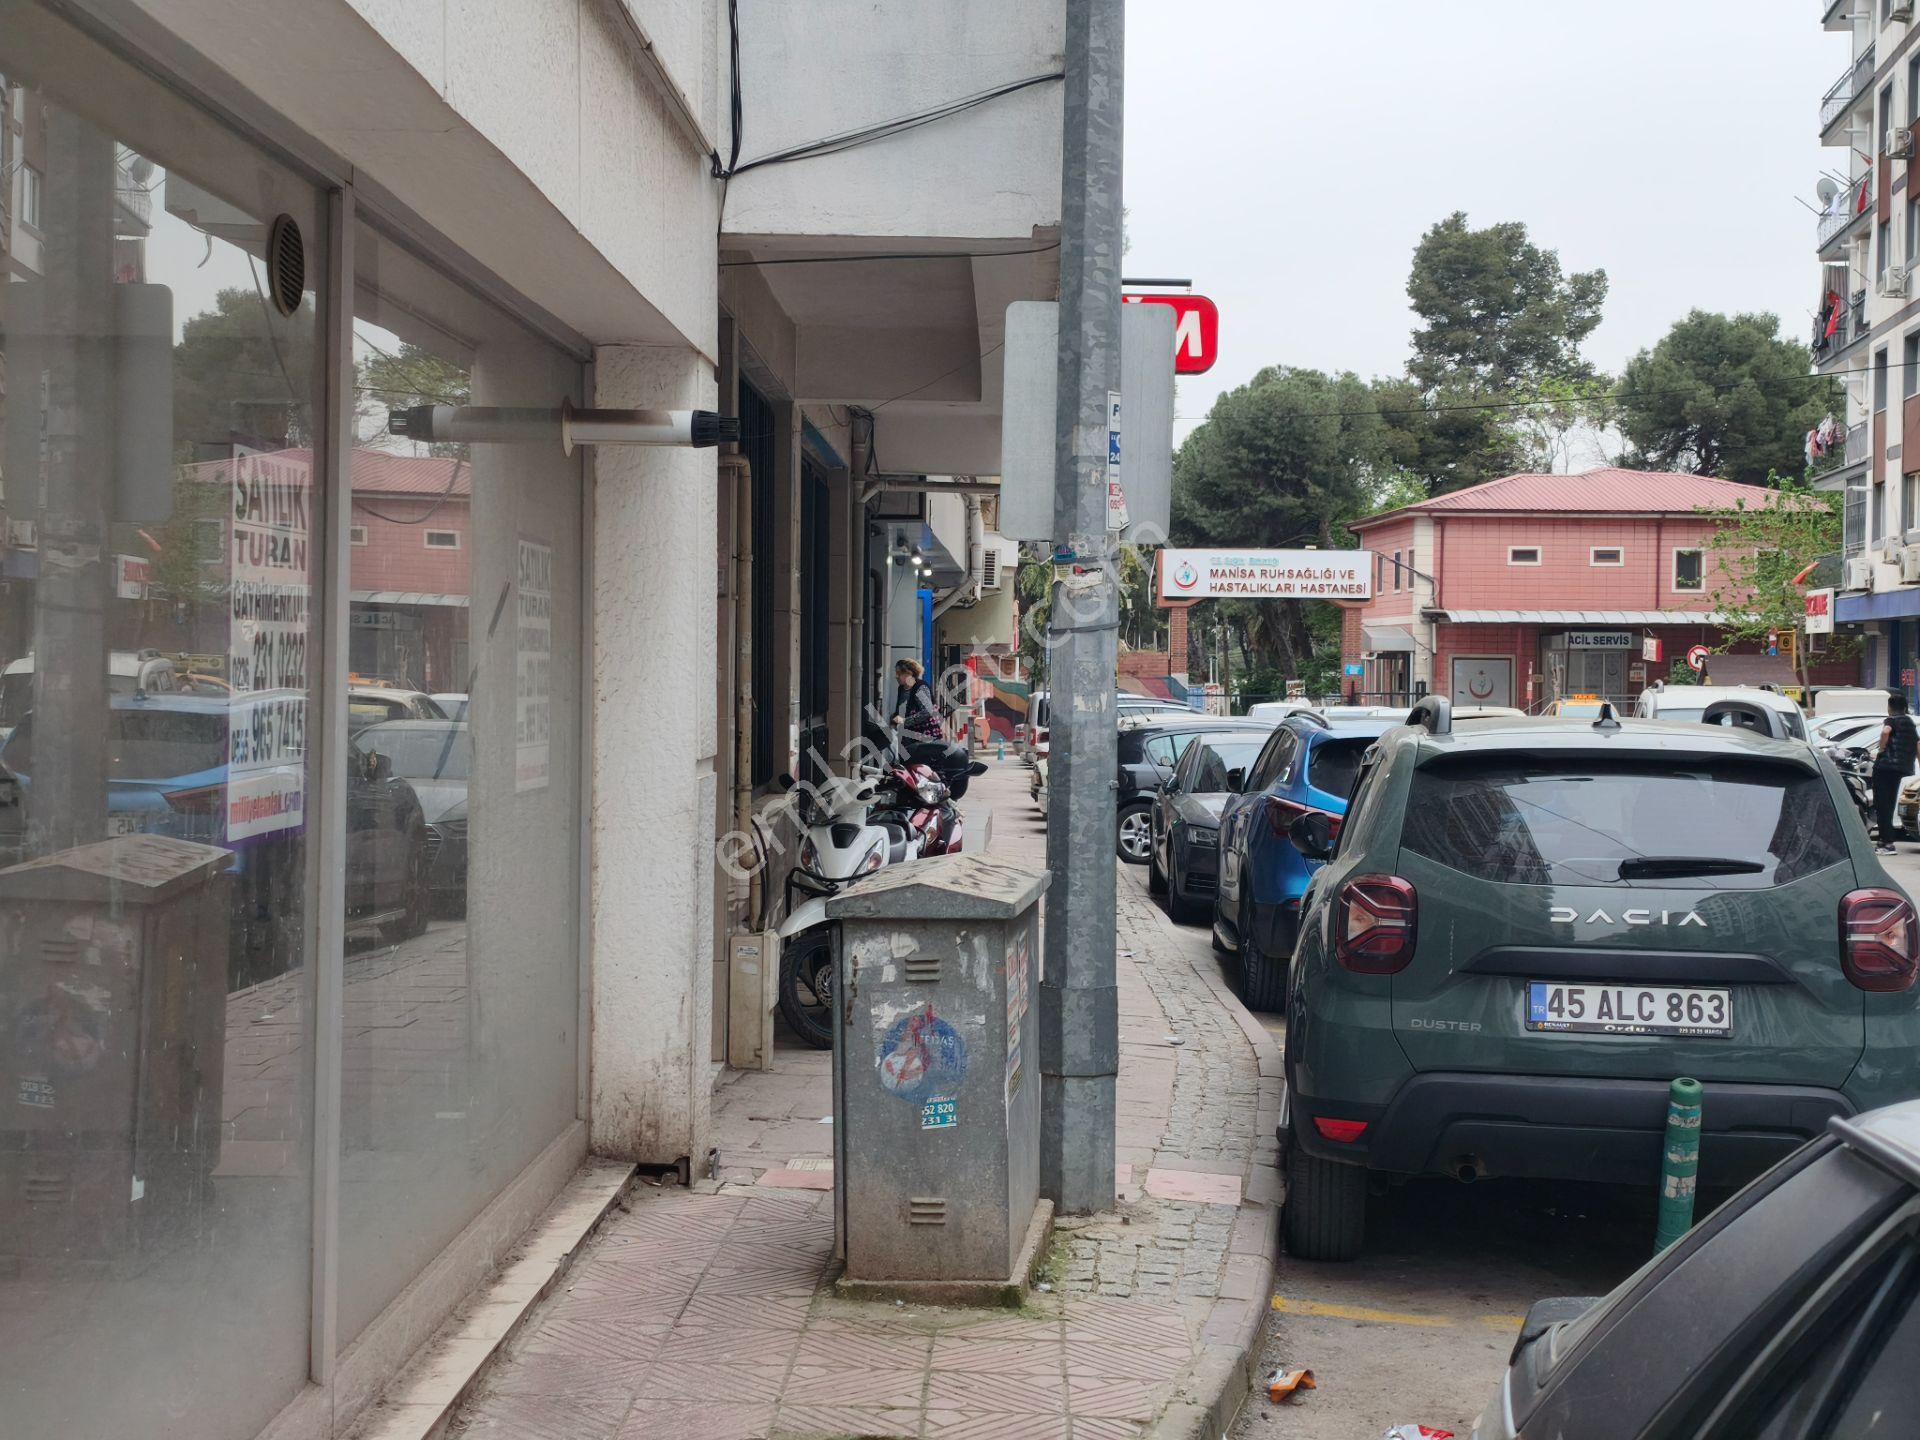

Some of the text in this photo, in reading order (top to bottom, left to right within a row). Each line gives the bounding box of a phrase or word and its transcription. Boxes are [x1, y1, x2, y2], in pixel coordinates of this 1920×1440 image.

[235, 452, 307, 530] SATILIK
[234, 529, 306, 572] TURAN
[1209, 567, 1256, 579] MANİSA
[1340, 570, 1355, 580] VE
[1209, 582, 1367, 595] HASTALIKLARI HASTANESİ
[1568, 634, 1630, 646] ACİL SERVİS
[253, 631, 274, 691] 231
[253, 702, 274, 763] 965
[1550, 906, 1708, 927] DACIA
[1533, 987, 1725, 1025] TR 45 ALC 863
[1411, 1019, 1482, 1032] DUSTER
[1604, 1024, 1645, 1033] Ordu
[937, 1103, 955, 1114] 820
